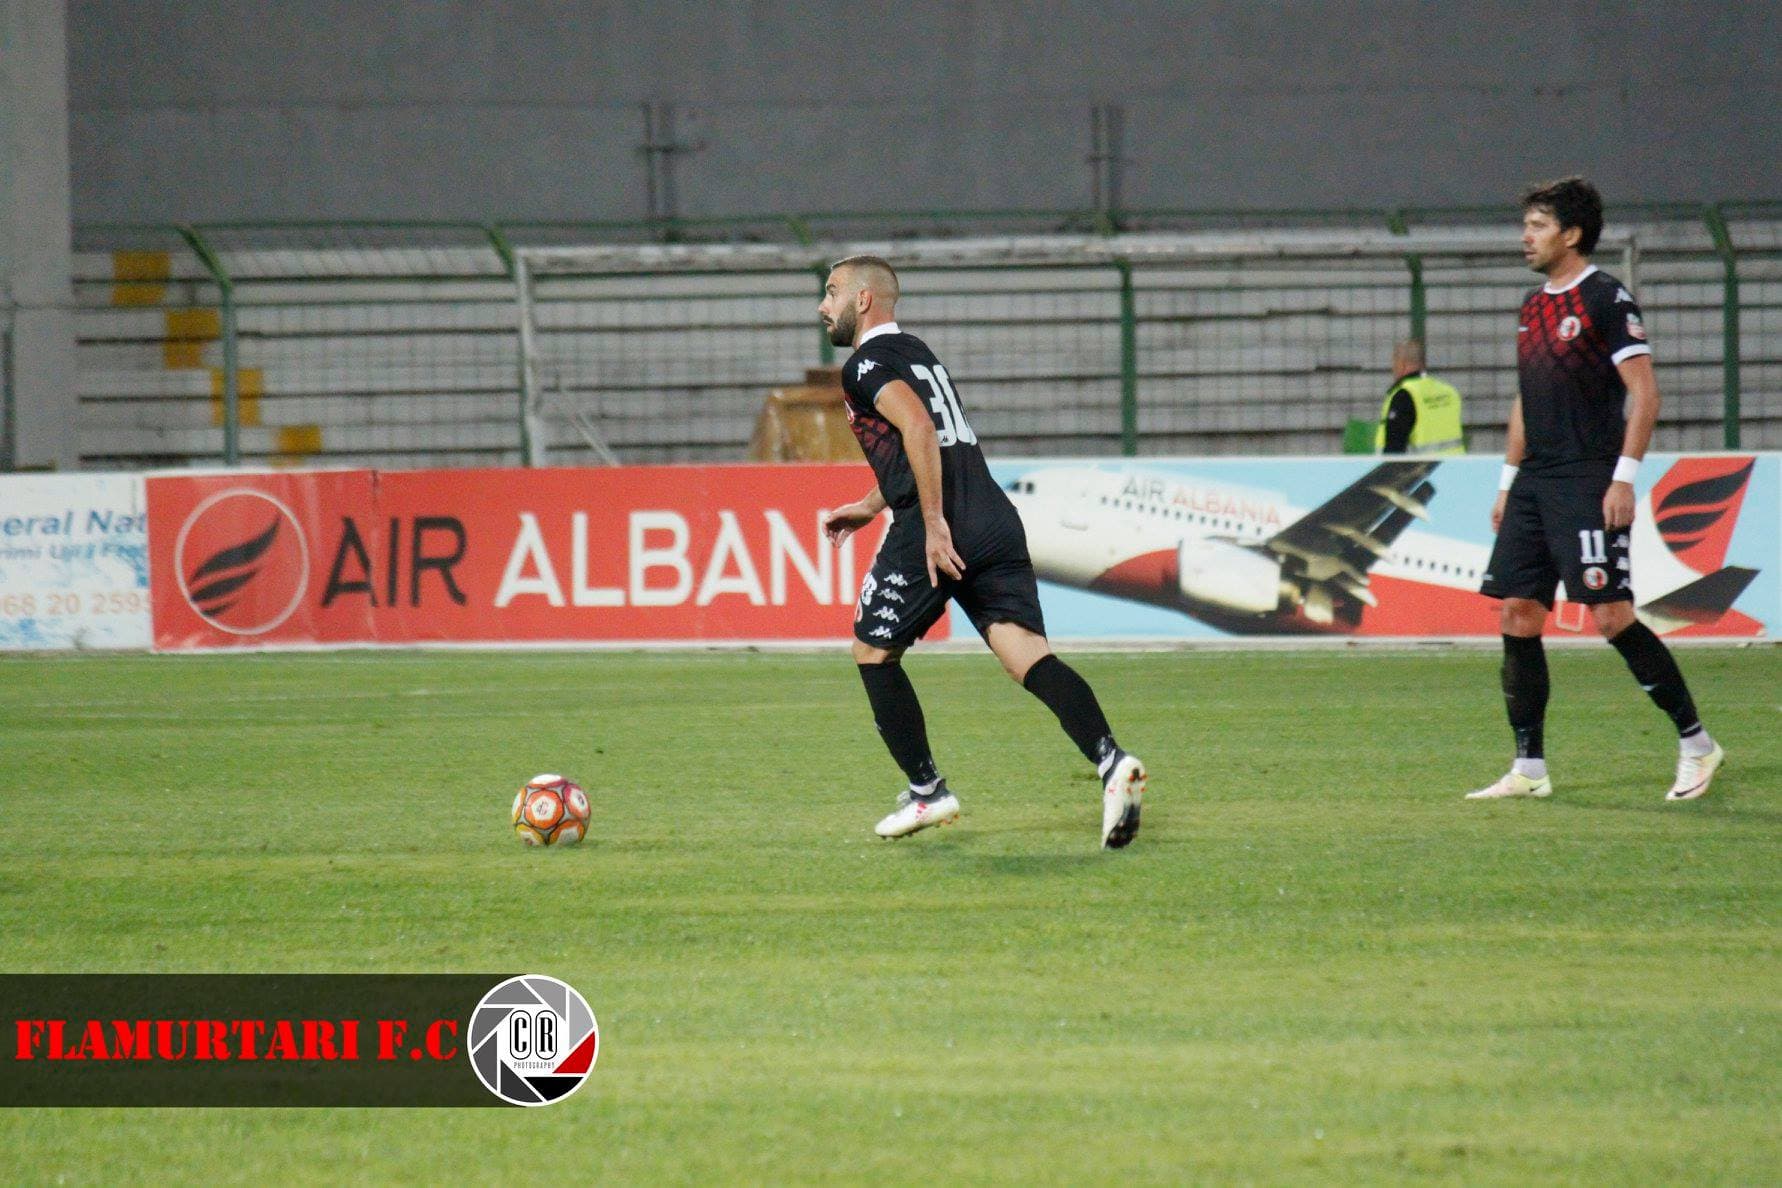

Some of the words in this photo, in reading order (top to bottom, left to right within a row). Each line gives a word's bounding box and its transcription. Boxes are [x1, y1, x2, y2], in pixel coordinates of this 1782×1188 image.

[1122, 475, 1166, 502] AIR
[1172, 484, 1281, 527] ALBANIA
[320, 515, 468, 608] AIR
[494, 509, 893, 607] ALBANI
[1578, 529, 1608, 564] 11
